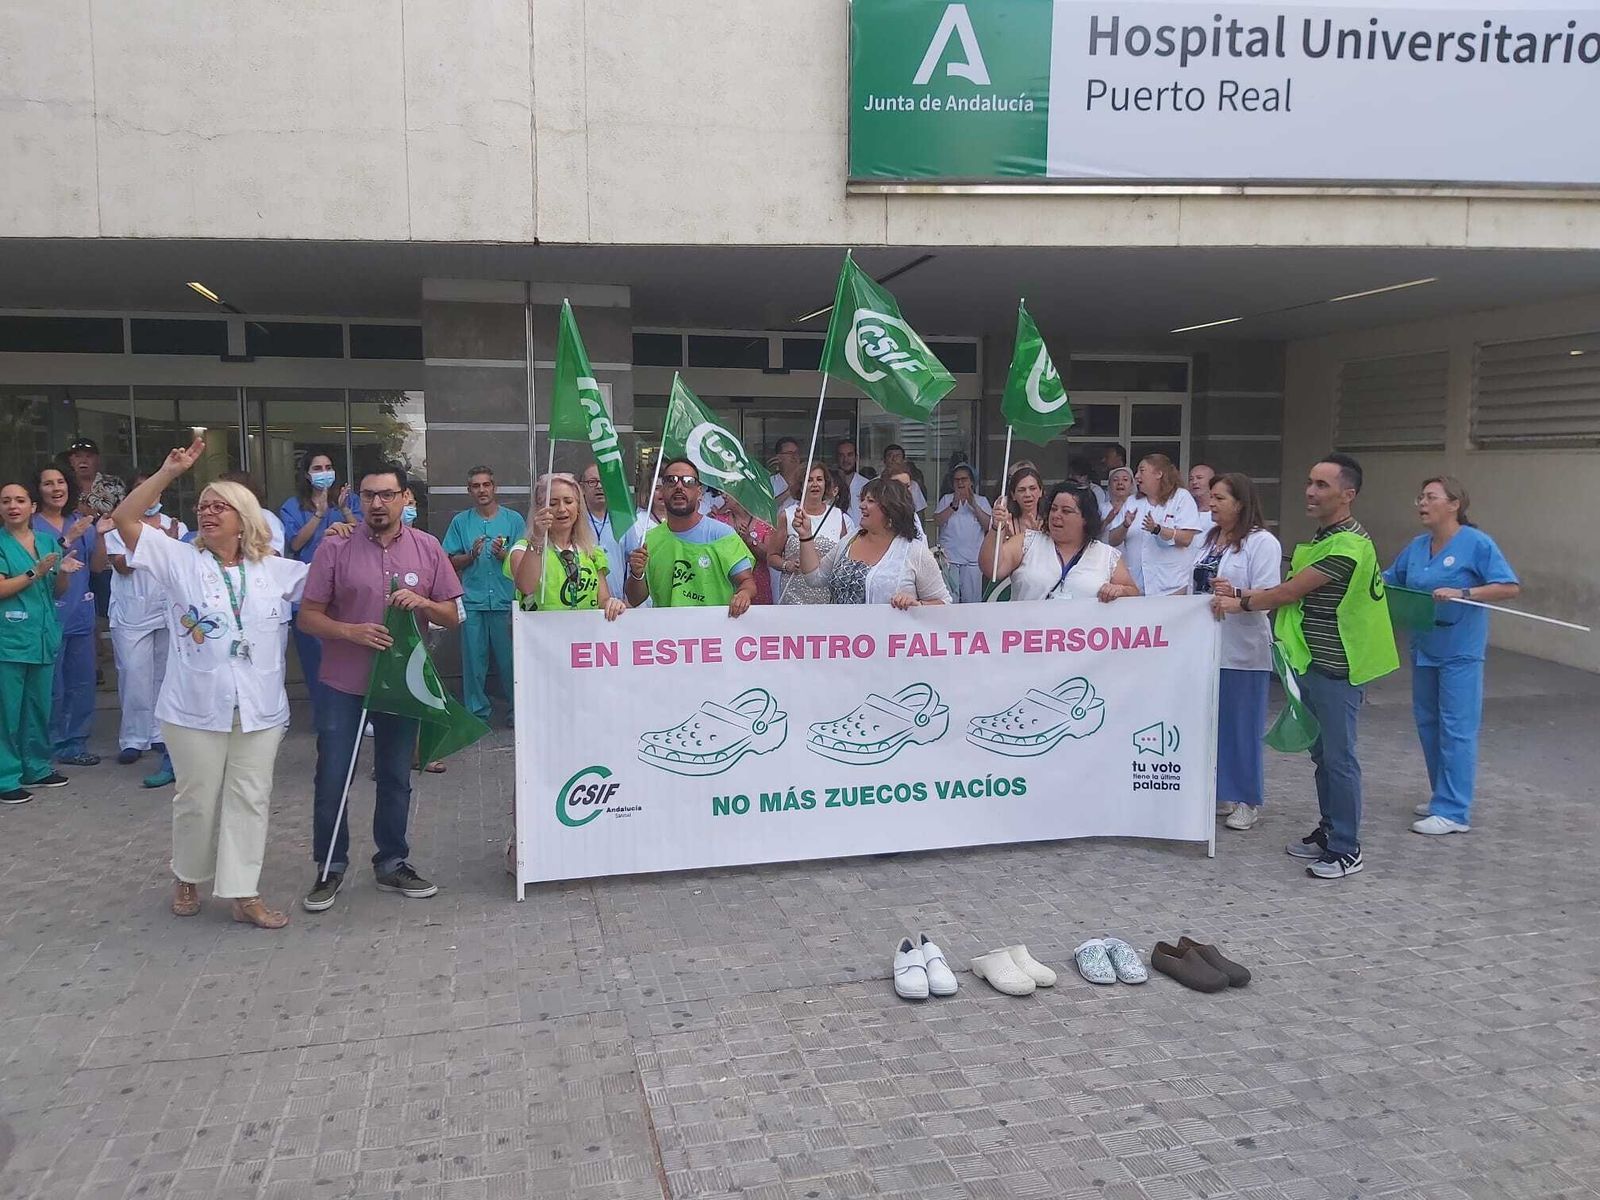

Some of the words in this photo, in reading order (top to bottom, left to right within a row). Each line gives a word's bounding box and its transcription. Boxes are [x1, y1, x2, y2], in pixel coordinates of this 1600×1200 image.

[1088, 14, 1287, 68] Hospital
[1301, 16, 1600, 65] Universitario
[863, 94, 915, 112] Junta
[919, 93, 942, 112] de
[945, 92, 1034, 112] Andalucía
[1086, 78, 1206, 112] Puerto
[1218, 77, 1292, 113] Real
[857, 324, 928, 373] CSIF
[570, 641, 619, 669] EN
[632, 637, 723, 666] ESTE
[734, 633, 876, 661] CENTRO
[887, 631, 991, 658] FALTA
[1000, 625, 1170, 654] PERSONAL
[1132, 760, 1146, 772] tu
[1151, 761, 1181, 773] voto
[568, 783, 620, 806] CSIF
[712, 795, 751, 816] NO
[759, 786, 817, 813] MÁS
[824, 782, 928, 808] ZUECOS
[934, 773, 1028, 800] VACÍOS
[1133, 779, 1180, 791] palabra
[606, 805, 642, 813] Andalucía
